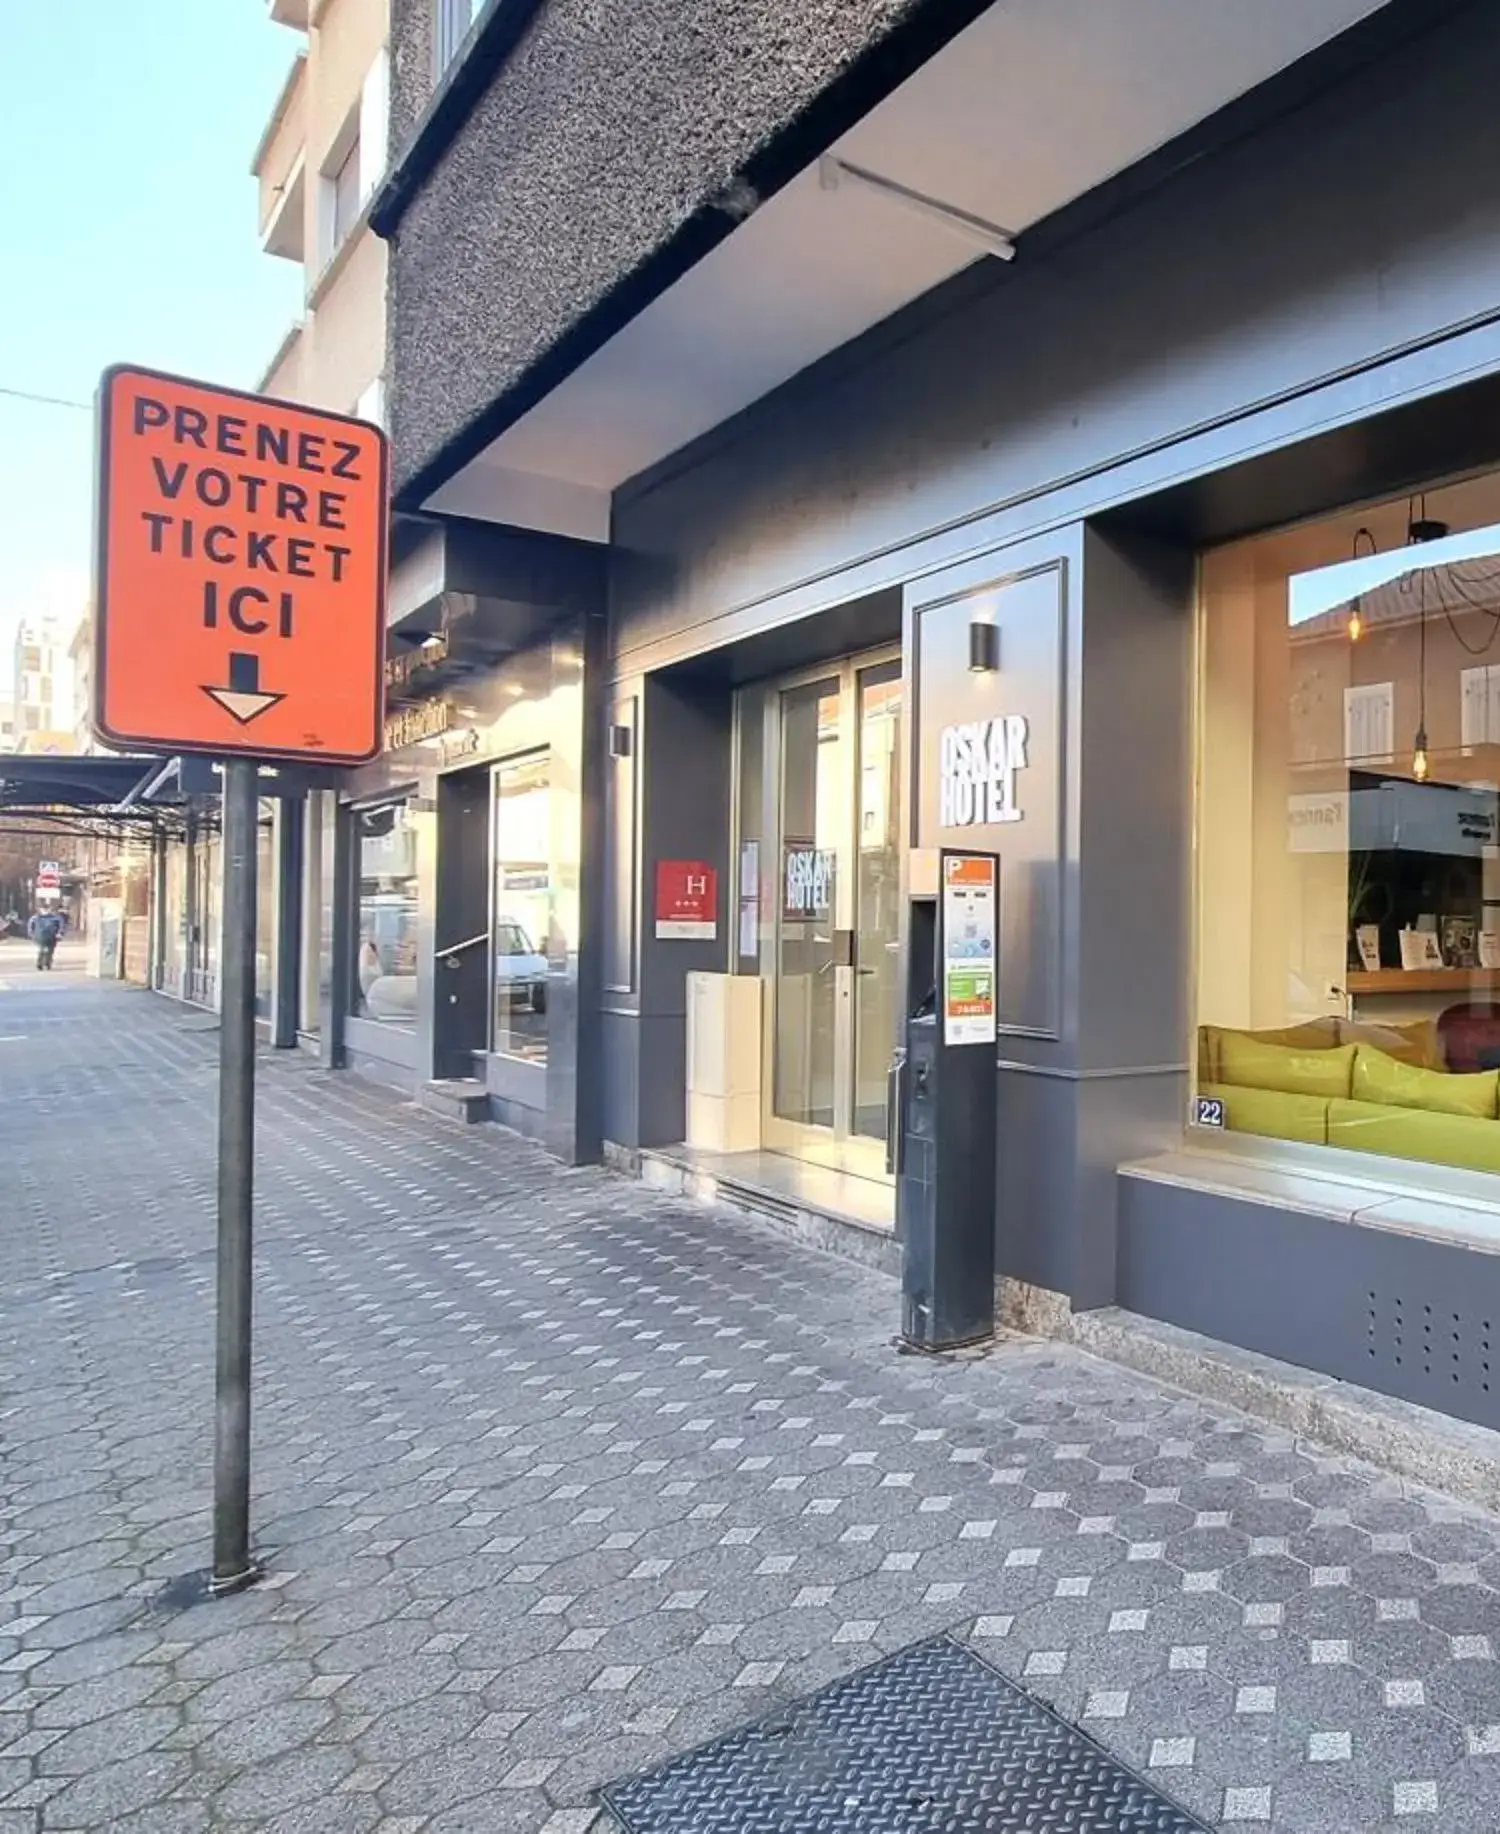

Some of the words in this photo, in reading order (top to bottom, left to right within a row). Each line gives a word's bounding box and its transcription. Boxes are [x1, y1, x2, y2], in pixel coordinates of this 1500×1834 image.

[133, 395, 361, 481] PRENEZ
[152, 456, 347, 530] VOTRE
[141, 511, 352, 583] TICKET
[203, 581, 293, 638] ICI
[941, 715, 1029, 778] OSKAR
[940, 769, 1025, 828] HOTEL
[687, 875, 706, 895] H
[787, 850, 836, 883] OSKAR
[787, 880, 830, 909] HOTEL
[1200, 1101, 1221, 1124] 22
